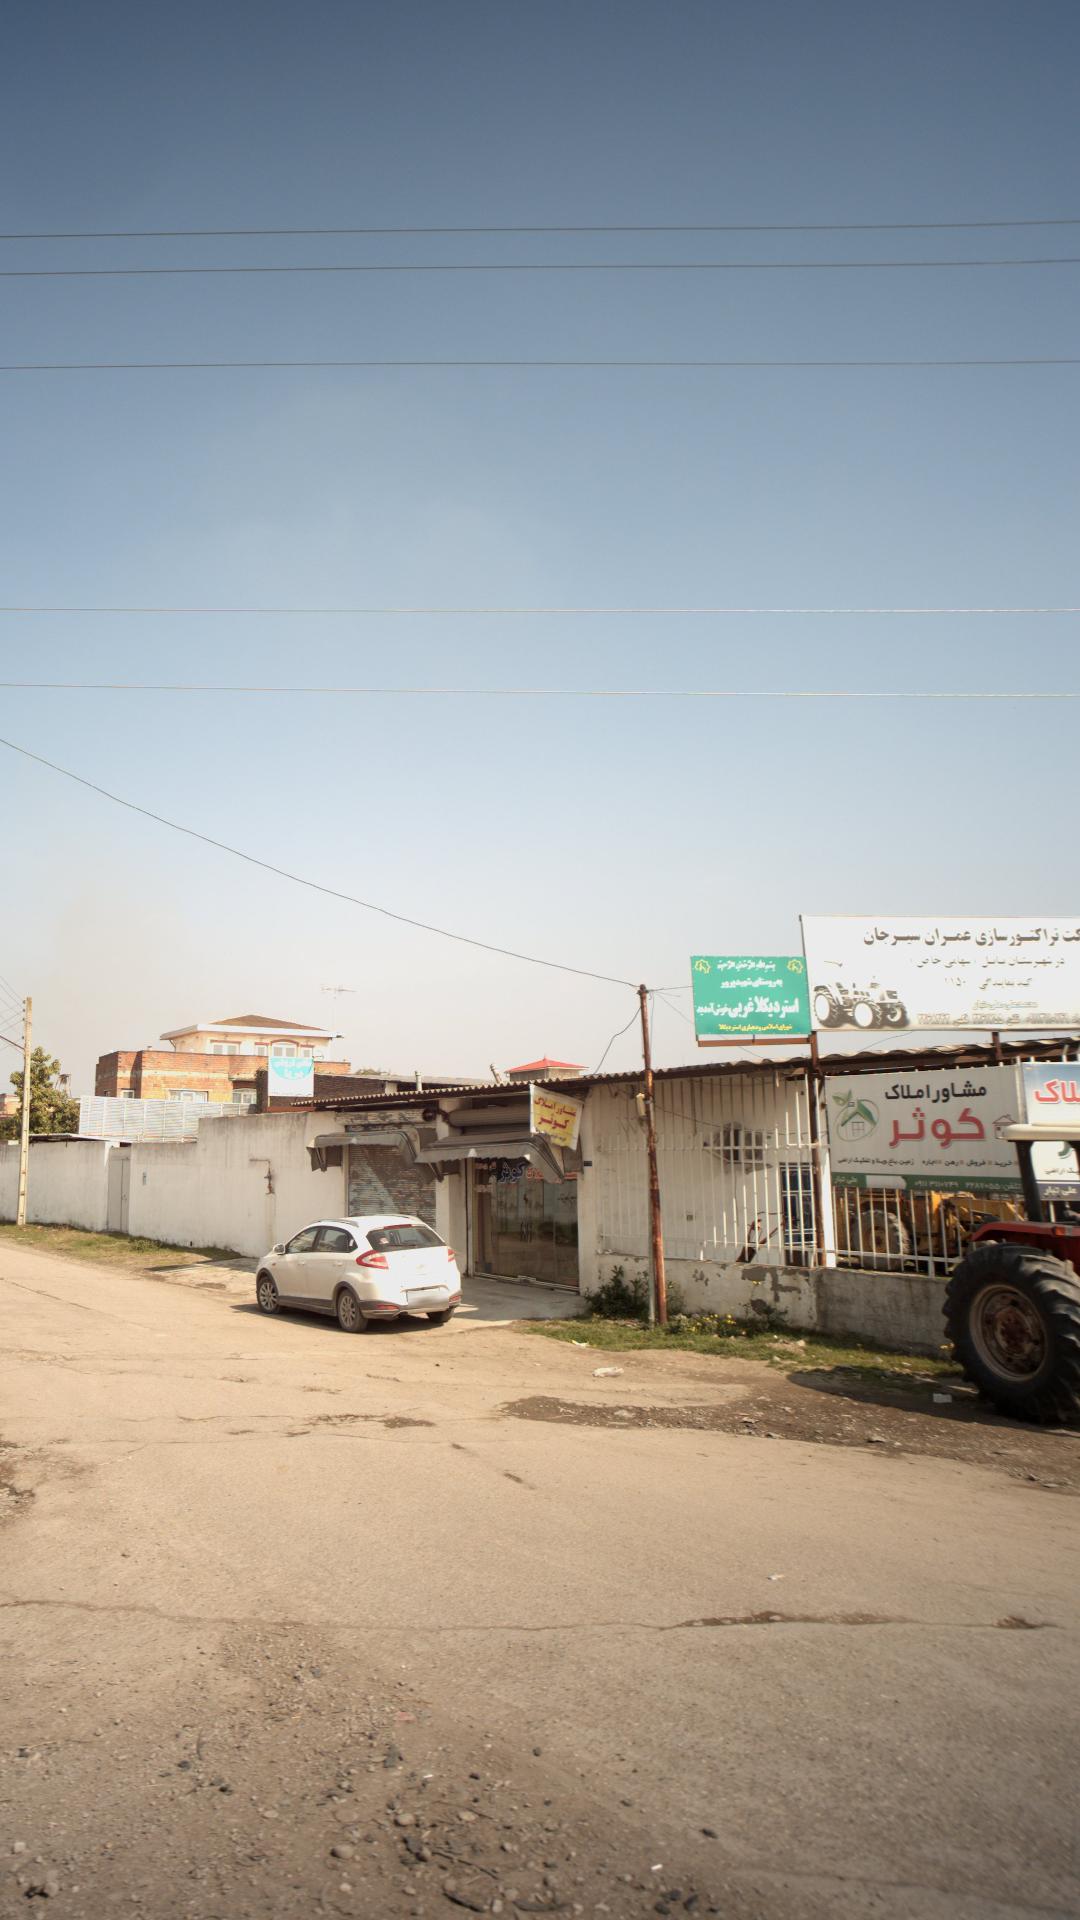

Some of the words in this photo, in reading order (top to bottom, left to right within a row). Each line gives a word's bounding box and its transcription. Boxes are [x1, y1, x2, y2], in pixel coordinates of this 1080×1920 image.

[863, 926, 921, 946] سیرجان
[924, 927, 971, 946] عمران
[1062, 927, 1080, 942] کت
[728, 997, 755, 1019] غربی
[884, 1083, 931, 1101] املاک
[932, 1080, 988, 1104] مشاور
[1034, 1079, 1080, 1103] لاک
[888, 1107, 986, 1149] کوثر
[944, 1159, 960, 1168] رهن
[966, 1159, 987, 1168] فروش
